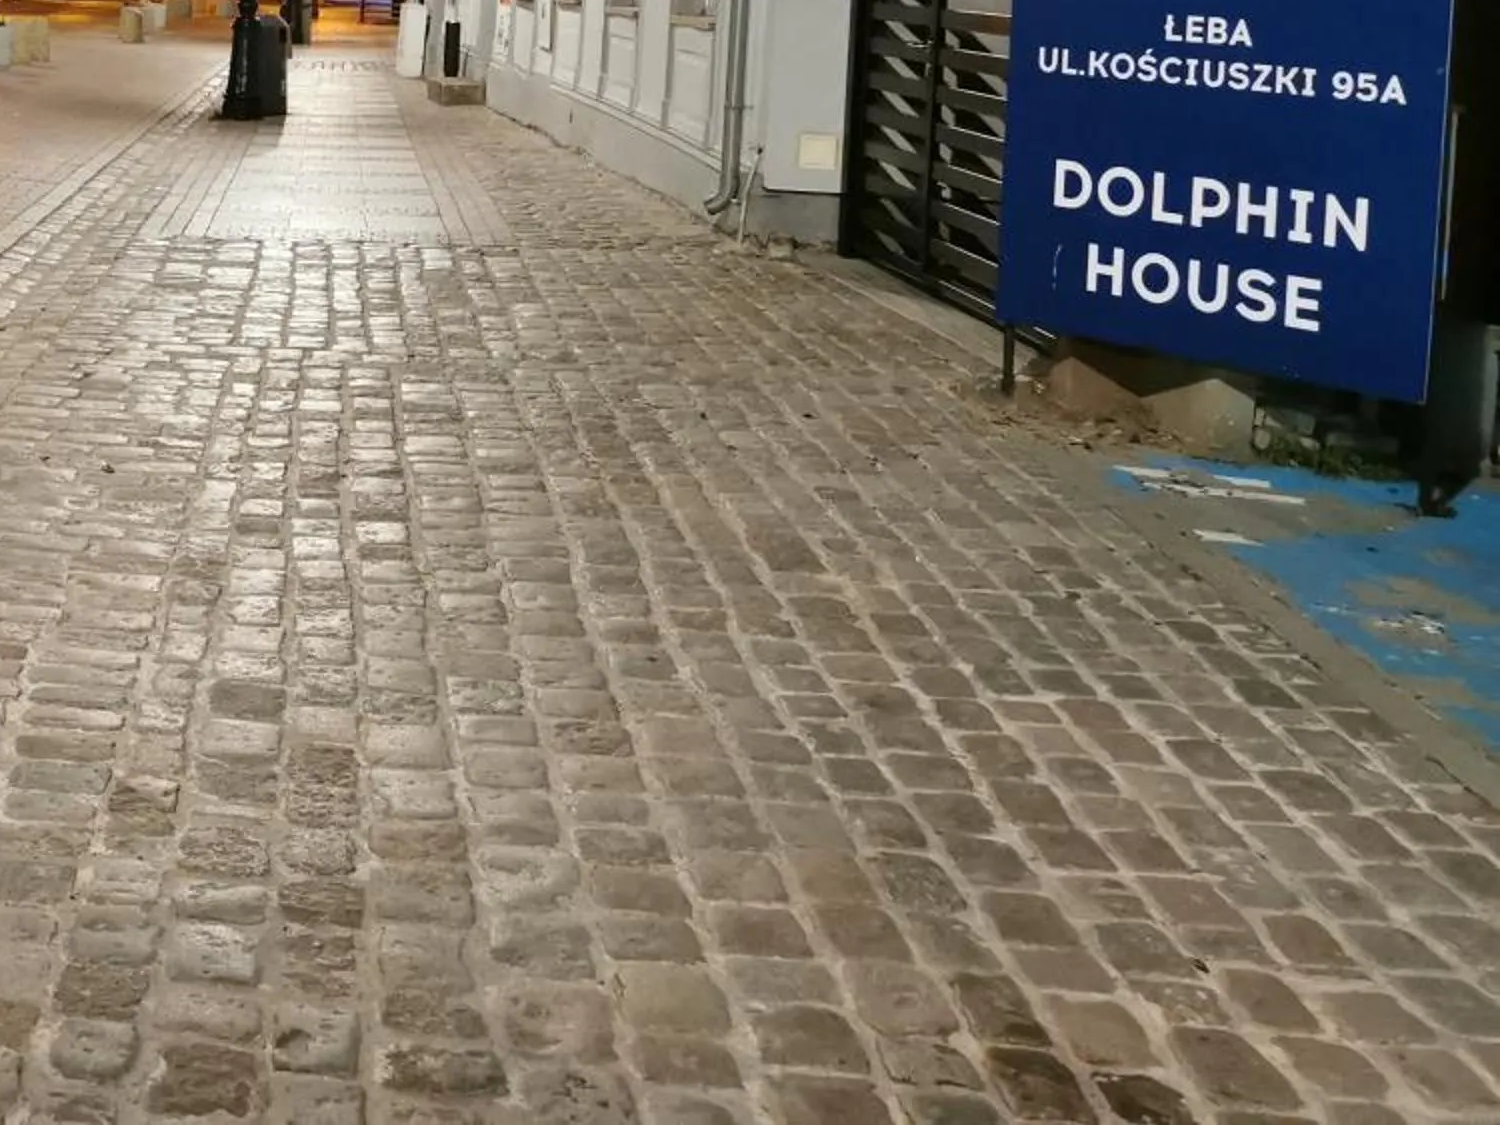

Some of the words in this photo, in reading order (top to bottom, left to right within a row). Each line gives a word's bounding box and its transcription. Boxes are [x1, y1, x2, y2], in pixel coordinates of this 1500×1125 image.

[1164, 14, 1253, 47] ŁEBA
[1038, 47, 1316, 97] UL.KOŚCIUSZKI
[1331, 70, 1407, 105] 95A
[1053, 158, 1369, 252] DOLPHIN
[1086, 243, 1323, 332] HOUSE
